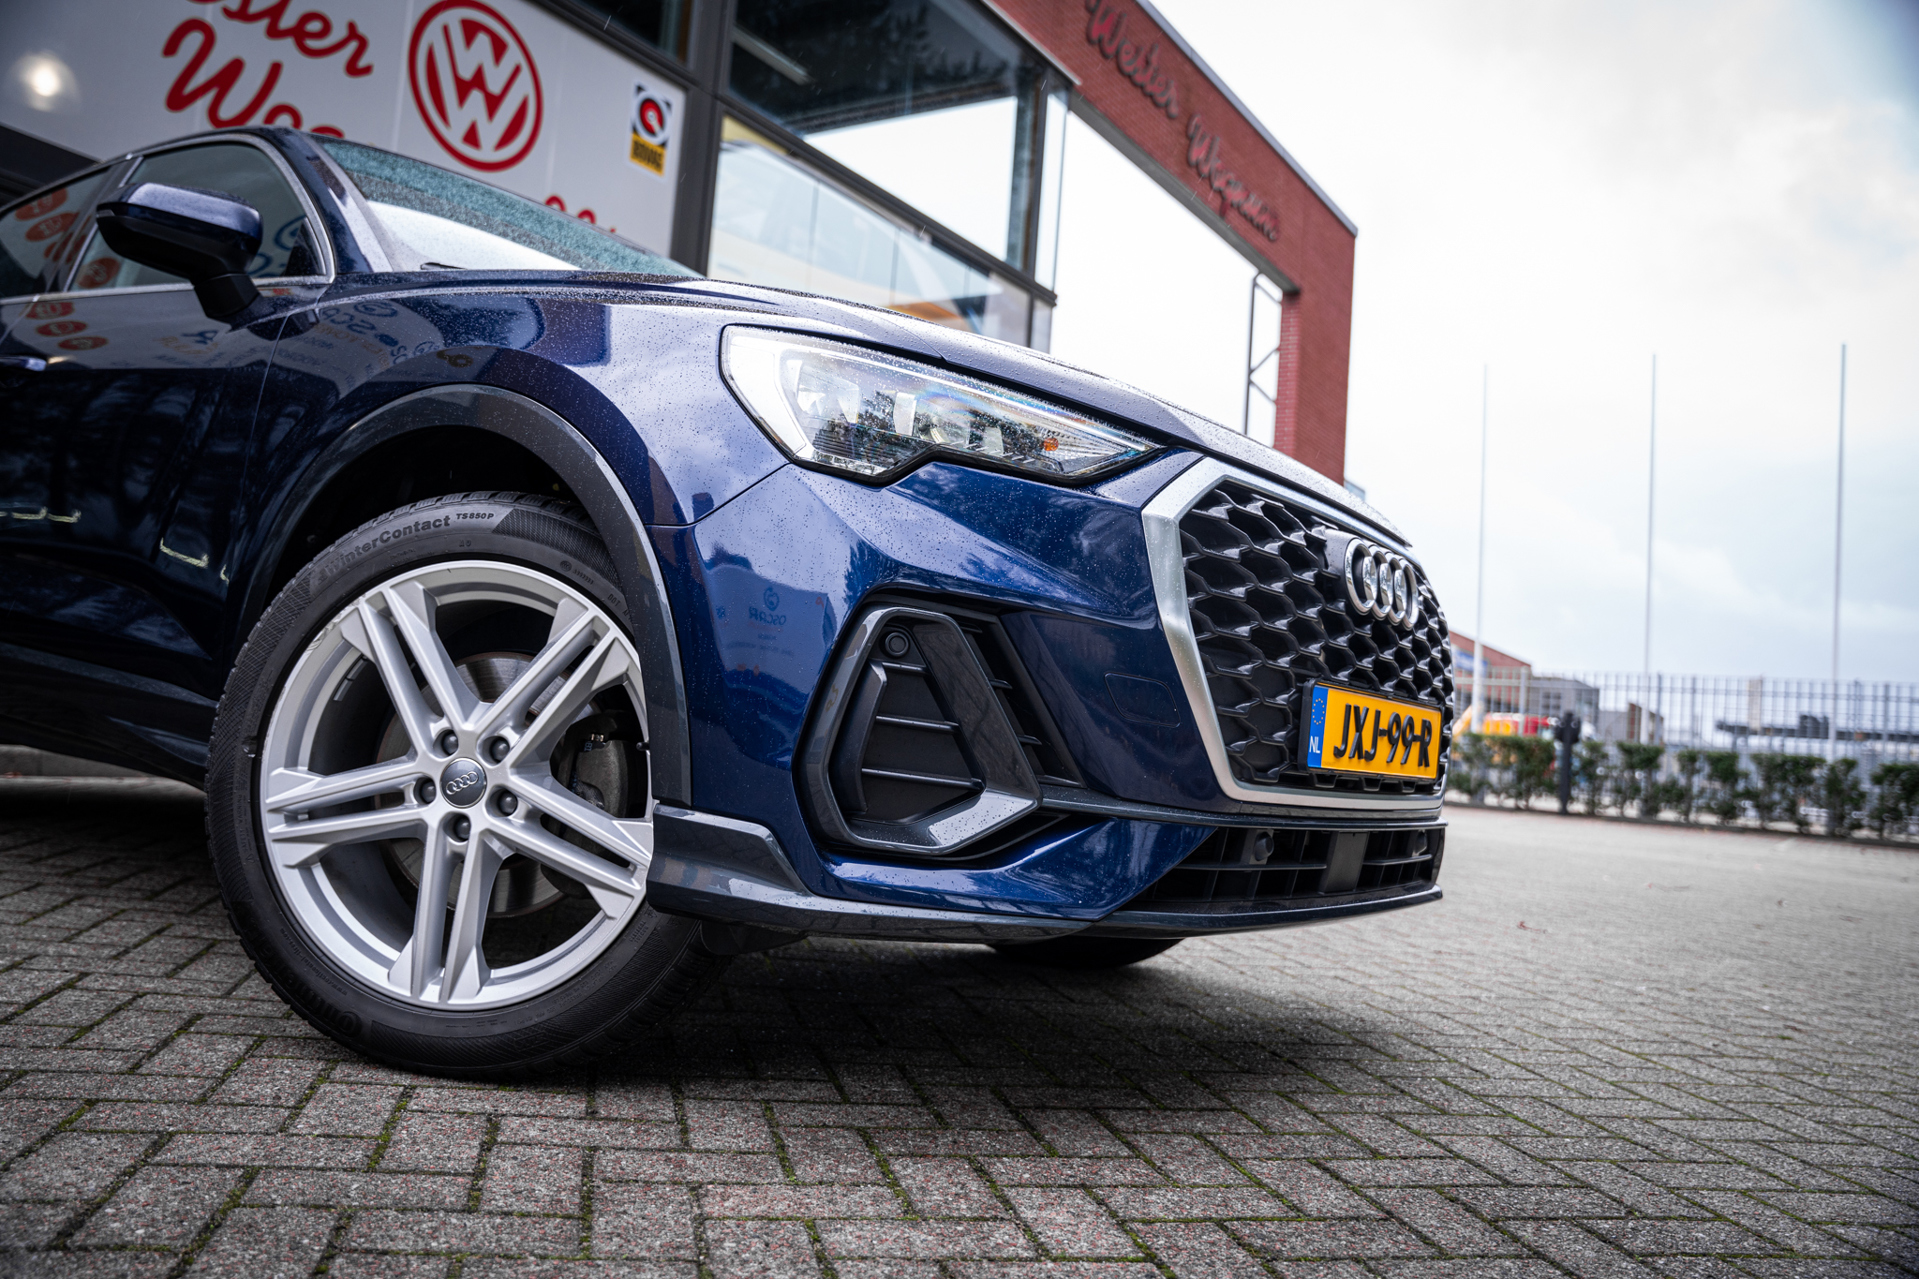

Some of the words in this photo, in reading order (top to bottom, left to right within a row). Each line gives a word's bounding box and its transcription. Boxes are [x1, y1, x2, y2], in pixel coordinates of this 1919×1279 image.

[325, 515, 451, 576] WinterContact
[1309, 735, 1321, 754] NL
[1333, 703, 1432, 768] JXJ-99-R
